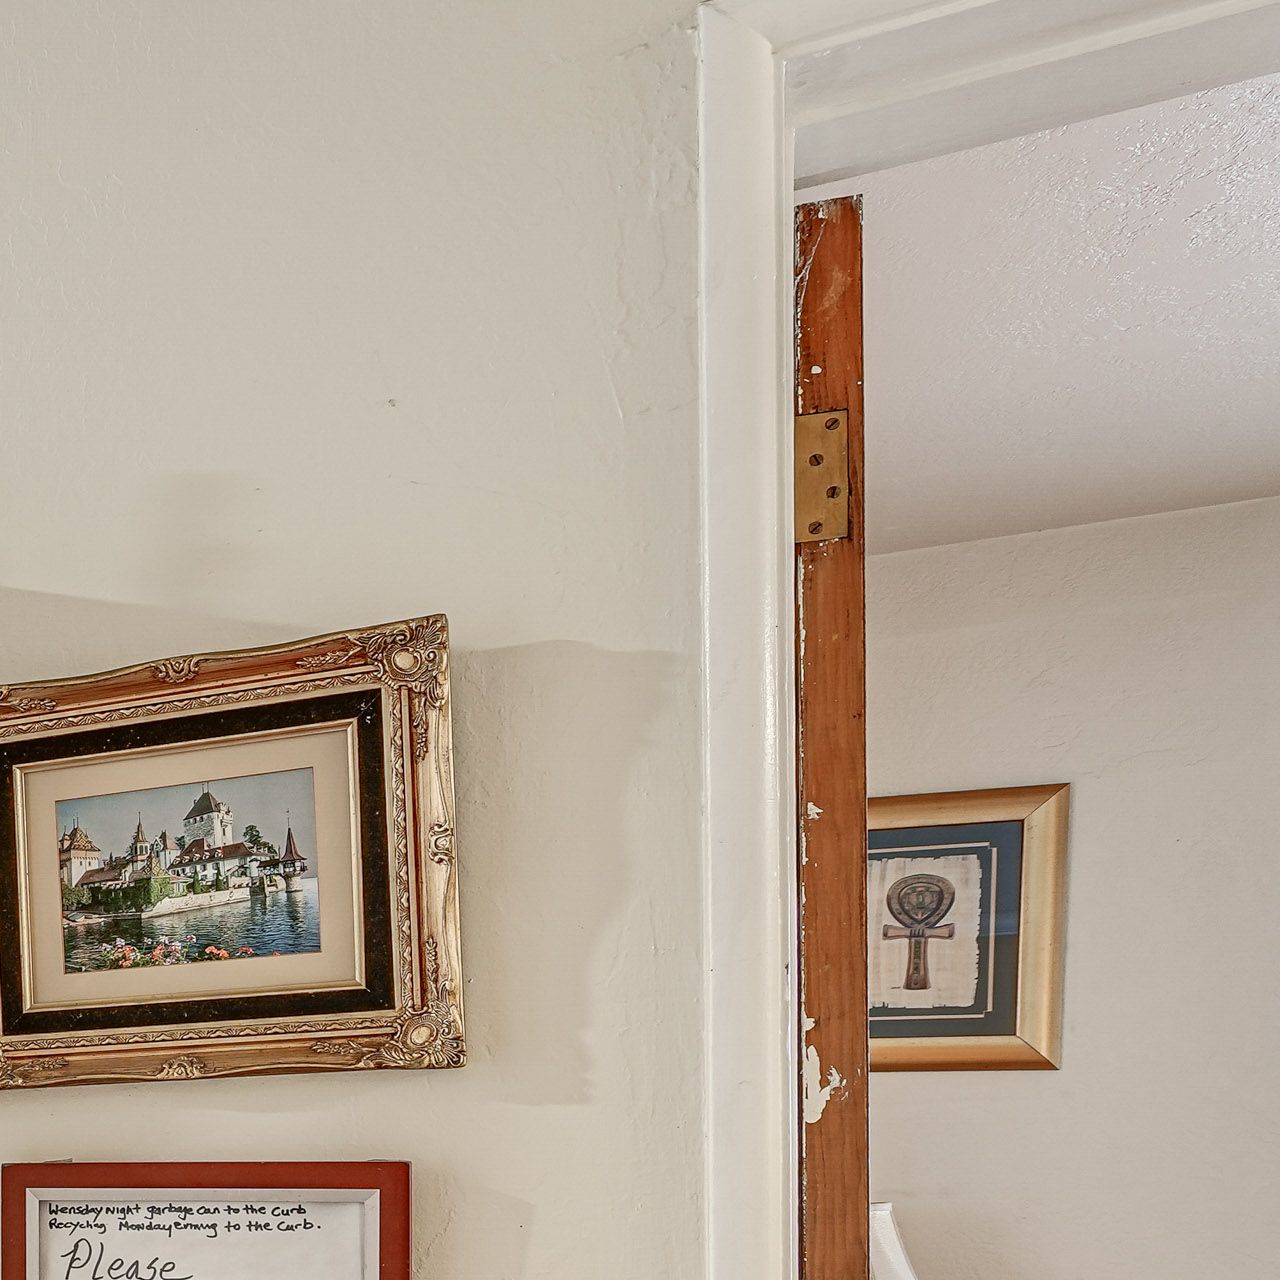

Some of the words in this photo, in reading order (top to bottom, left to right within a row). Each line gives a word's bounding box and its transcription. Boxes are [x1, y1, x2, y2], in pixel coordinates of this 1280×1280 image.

[223, 1204, 240, 1215] to
[242, 1203, 267, 1215] the
[224, 1220, 241, 1233] to
[245, 1219, 273, 1232] the
[60, 1237, 194, 1280] Please
